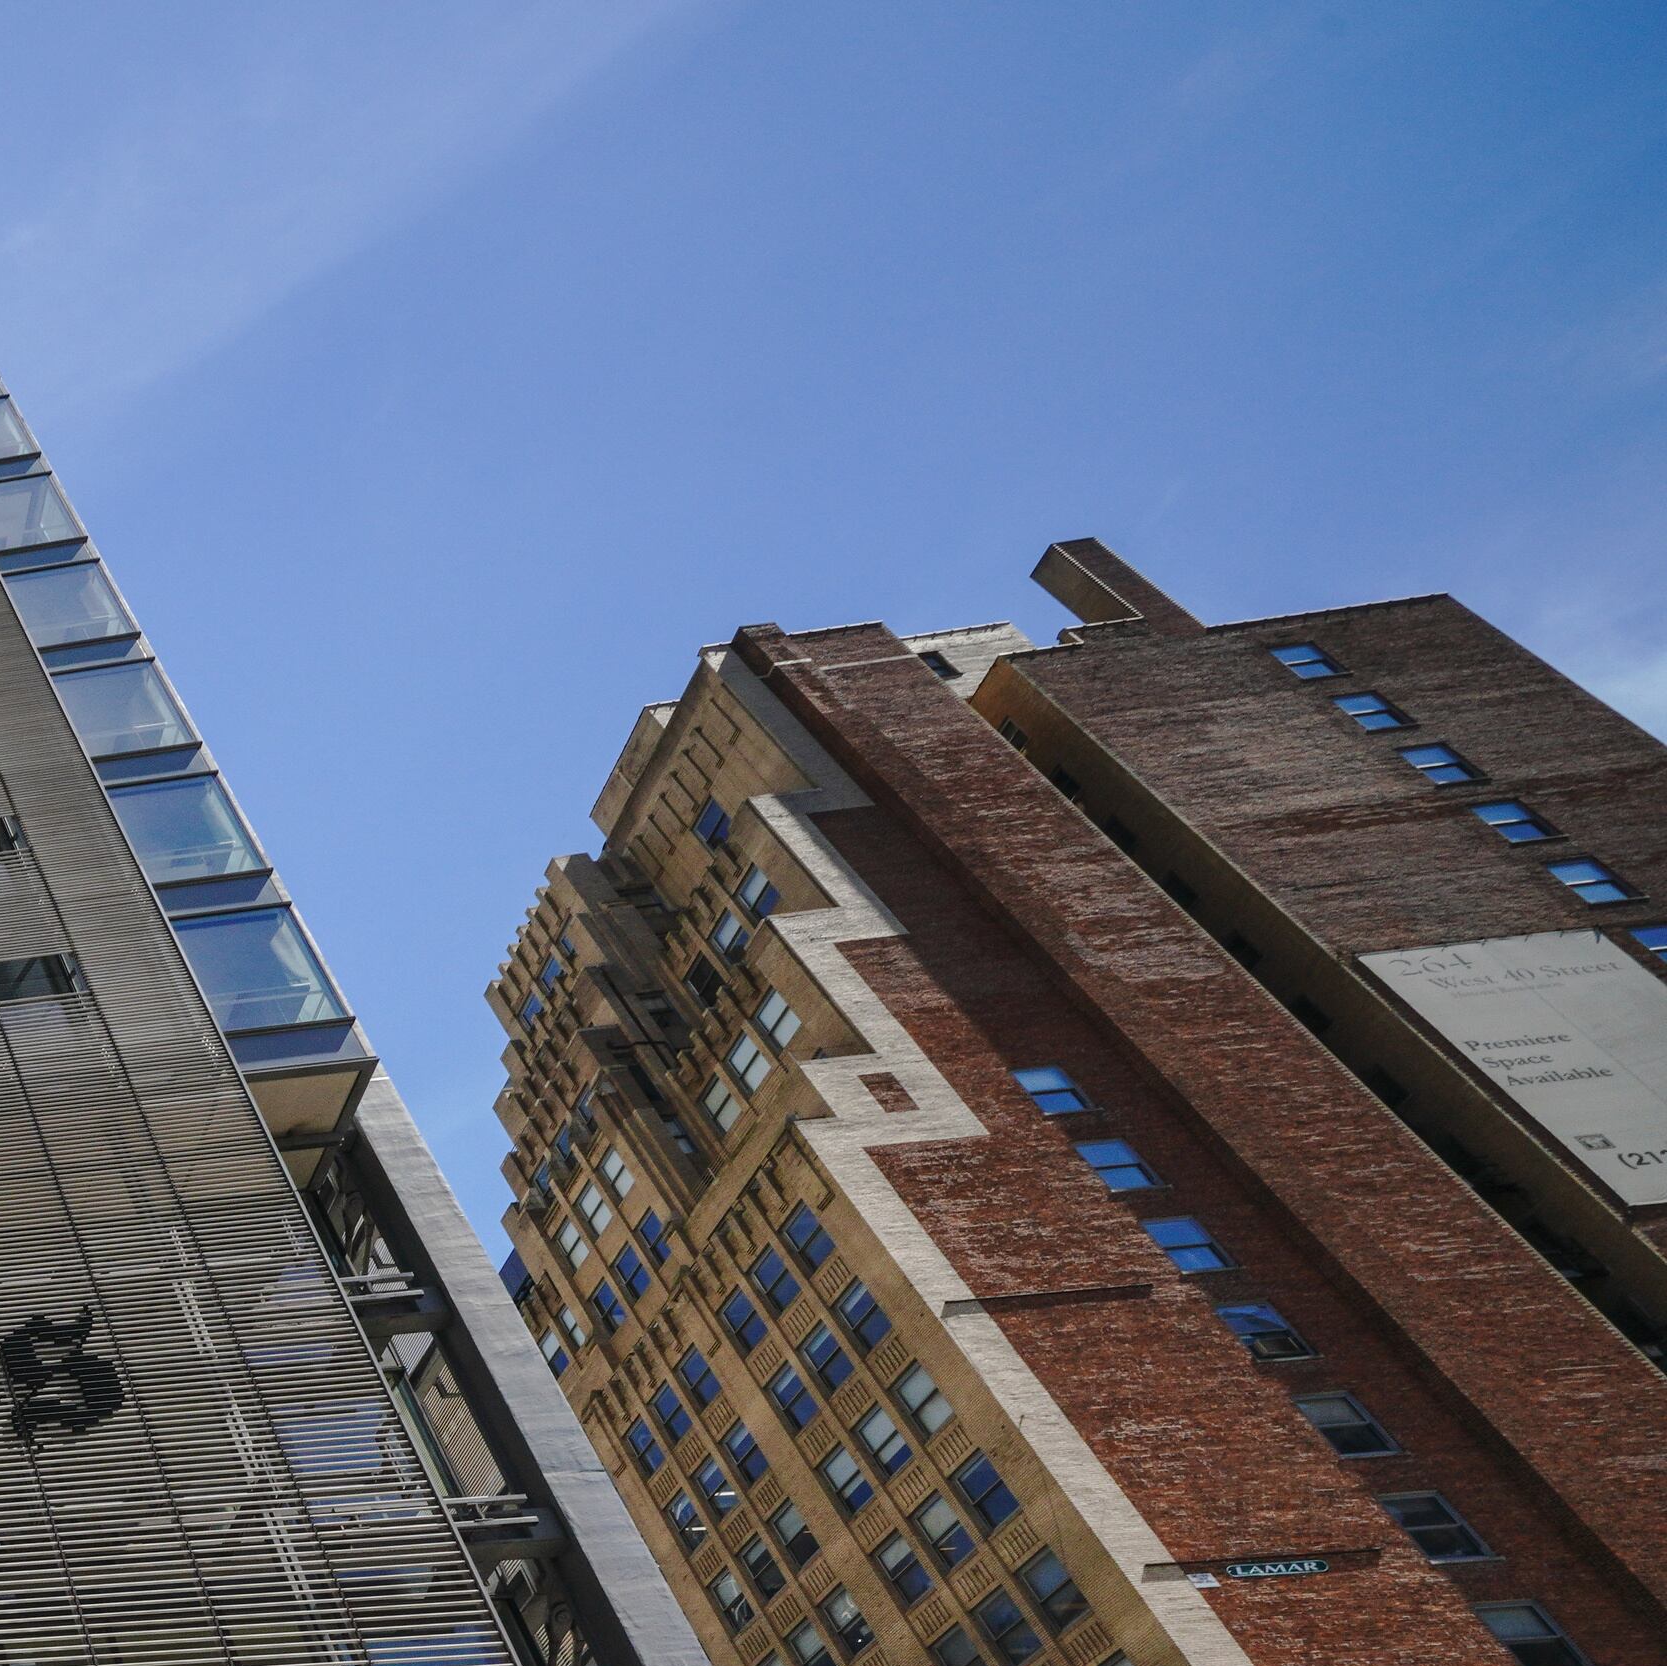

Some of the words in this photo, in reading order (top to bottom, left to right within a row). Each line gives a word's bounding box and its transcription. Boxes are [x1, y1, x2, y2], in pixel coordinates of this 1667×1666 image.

[1388, 952, 1473, 976] 264
[1429, 975, 1498, 990] West
[1504, 967, 1536, 982] 40
[1538, 960, 1624, 979] Street
[1463, 1033, 1572, 1052] Premiere
[1481, 1053, 1554, 1071] Space
[1506, 1066, 1613, 1087] Available
[1236, 1561, 1319, 1576] LAMAR
